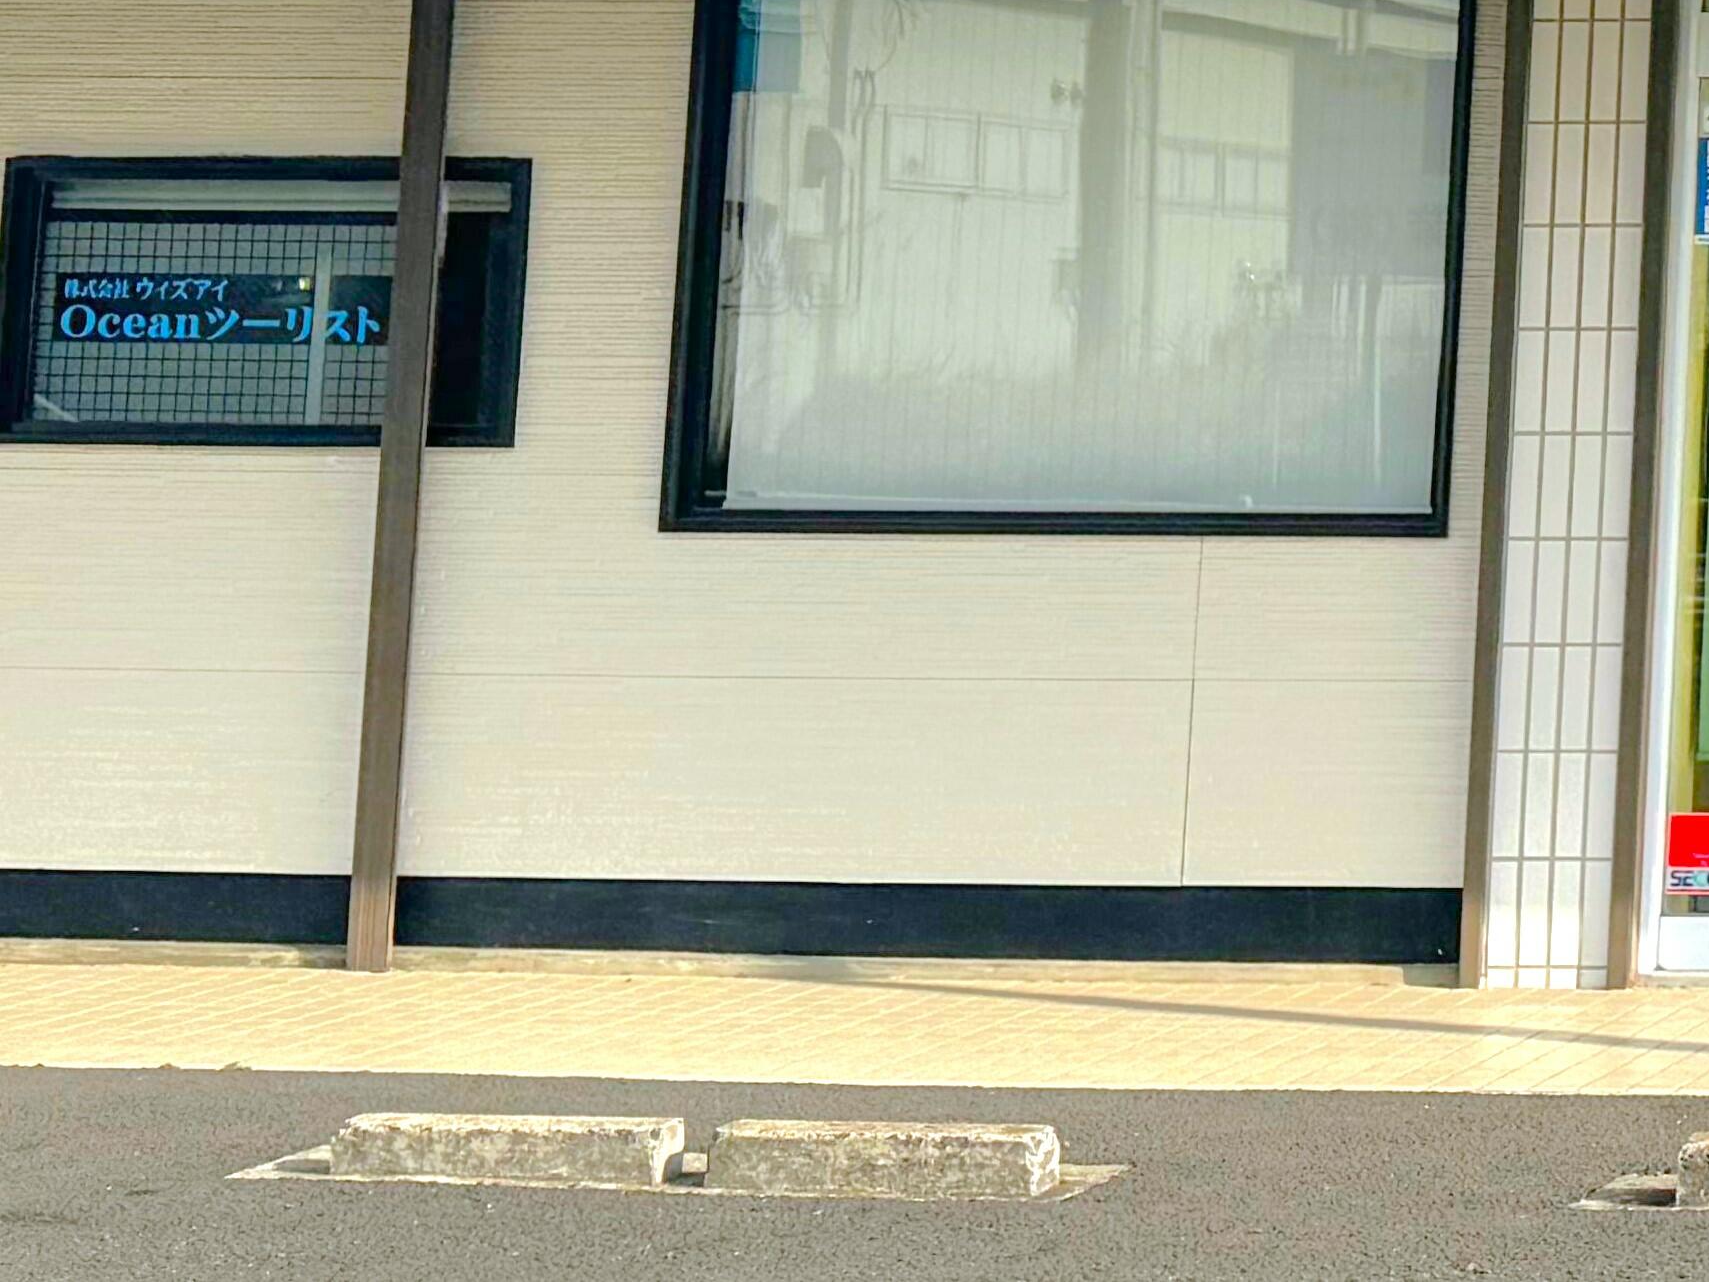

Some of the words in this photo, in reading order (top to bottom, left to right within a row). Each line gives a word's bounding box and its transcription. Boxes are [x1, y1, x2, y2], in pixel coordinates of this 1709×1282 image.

[60, 304, 381, 345] Oceanツーリスト
